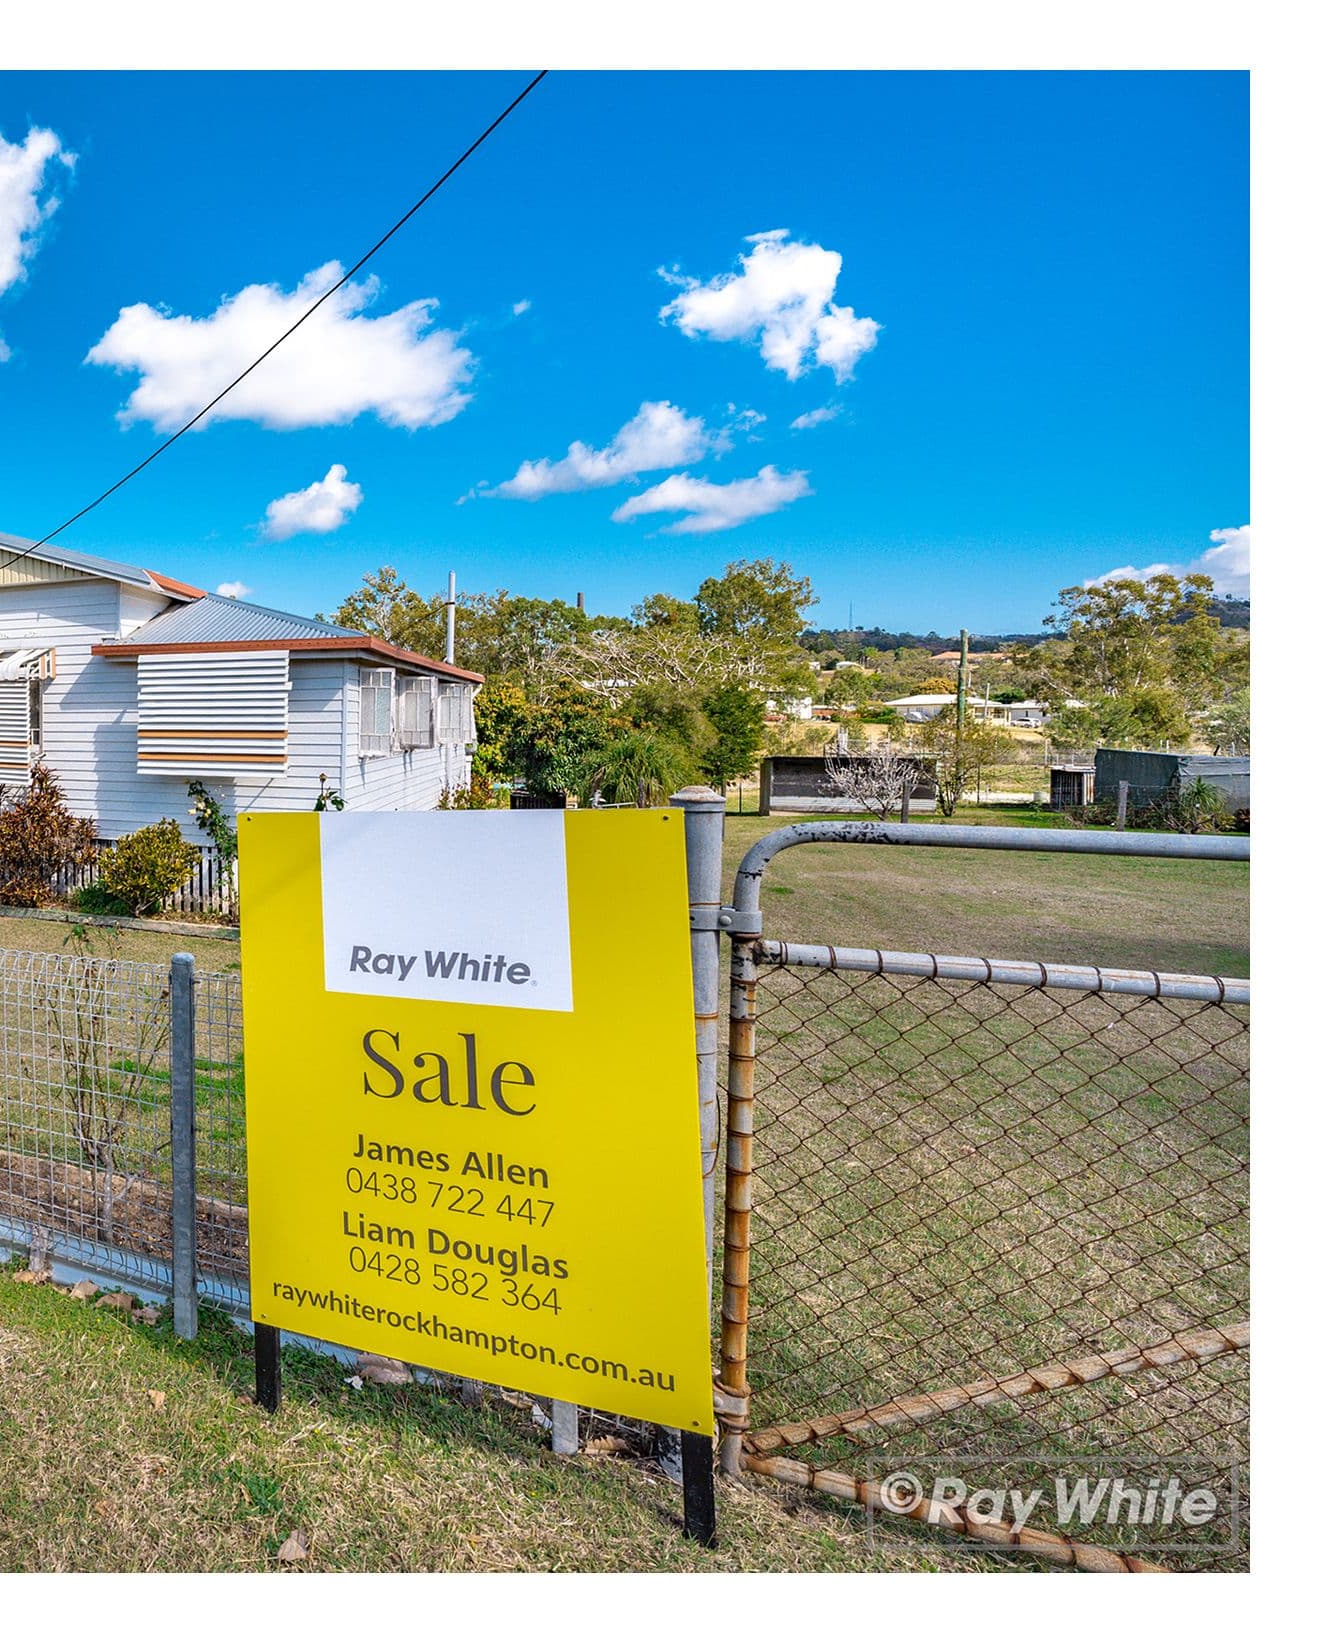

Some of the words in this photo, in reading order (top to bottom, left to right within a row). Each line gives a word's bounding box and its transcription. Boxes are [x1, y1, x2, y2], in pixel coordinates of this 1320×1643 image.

[349, 945, 418, 982] Ray
[424, 950, 531, 985] White
[362, 1029, 537, 1117] Sale
[353, 1133, 450, 1173] James
[460, 1151, 549, 1189] Allen
[346, 1167, 418, 1204] 0438
[427, 1181, 485, 1217] 722
[495, 1194, 555, 1228] 447
[343, 1210, 415, 1250] Liam
[427, 1228, 569, 1280] Douglas
[349, 1246, 421, 1286] 0428
[432, 1263, 489, 1301] 582
[501, 1278, 562, 1316] 364
[273, 1281, 676, 1393] raywhiterockhampton.com.au
